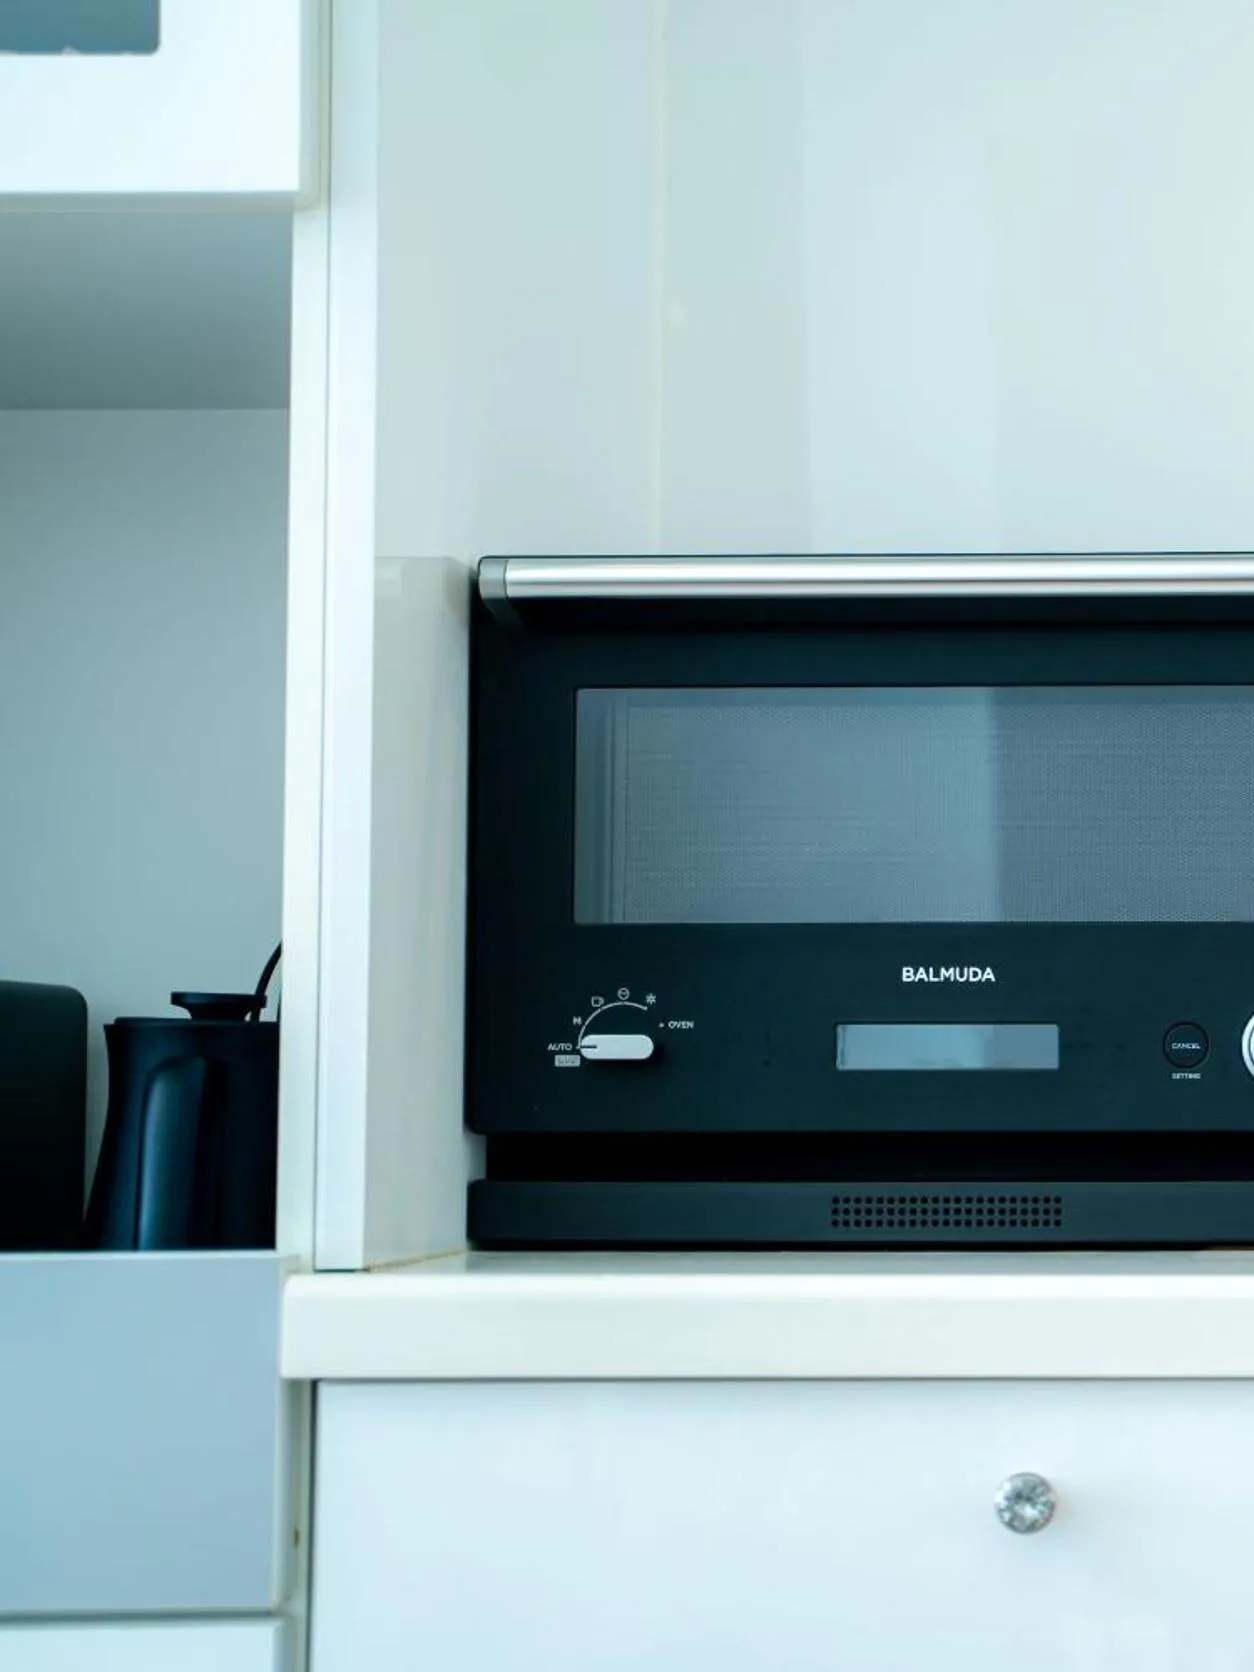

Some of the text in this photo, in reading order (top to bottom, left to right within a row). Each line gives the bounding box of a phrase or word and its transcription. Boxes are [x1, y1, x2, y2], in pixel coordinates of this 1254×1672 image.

[902, 966, 995, 982] BALMUDA
[667, 1020, 695, 1029] OVEN
[548, 1043, 573, 1051] AUTO
